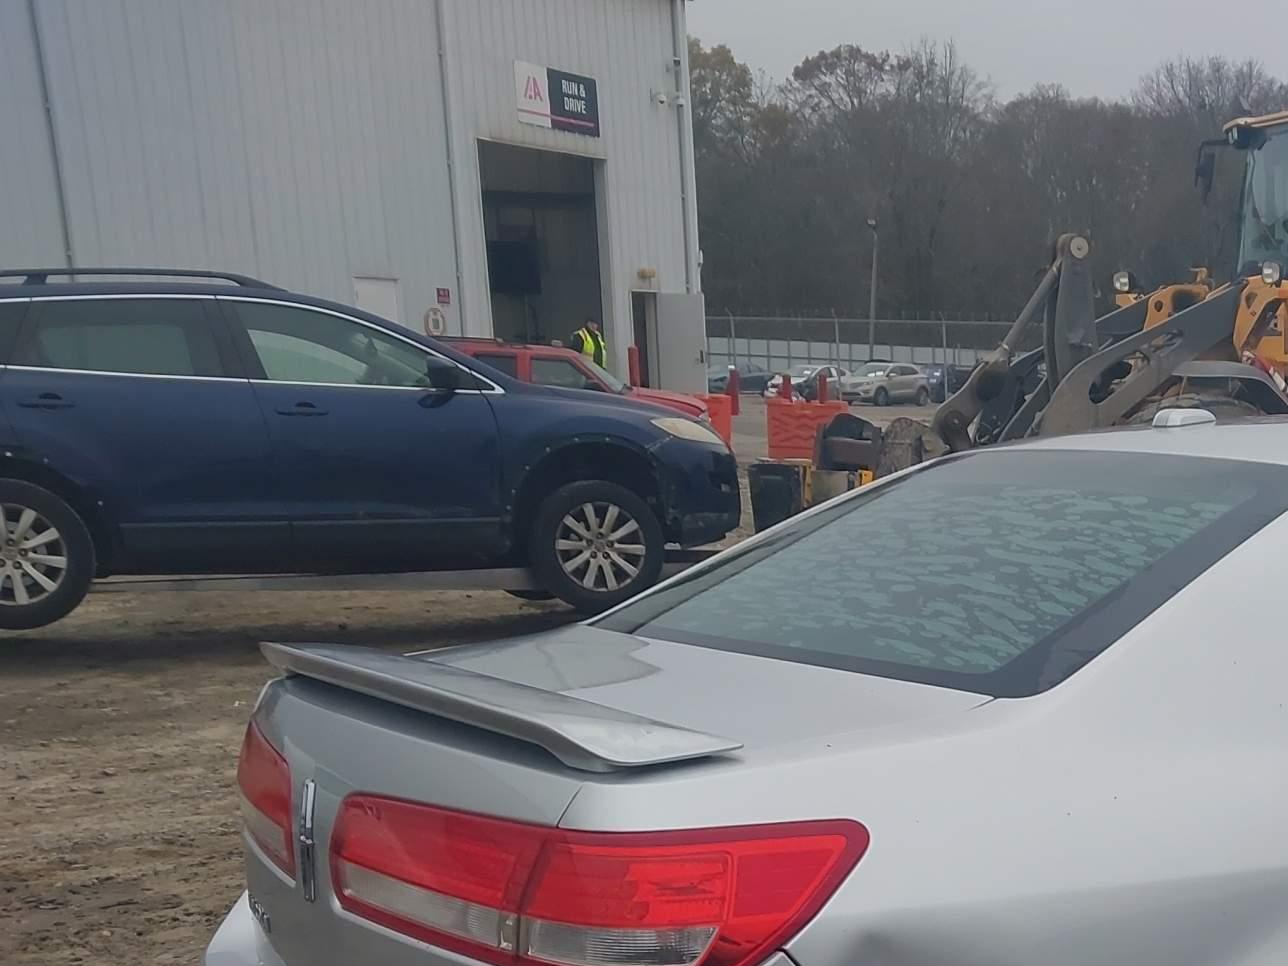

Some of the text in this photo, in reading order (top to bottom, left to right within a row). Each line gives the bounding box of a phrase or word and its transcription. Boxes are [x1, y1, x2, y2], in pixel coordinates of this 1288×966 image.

[561, 79, 586, 98] RUN &
[563, 96, 587, 114] DRIVE
